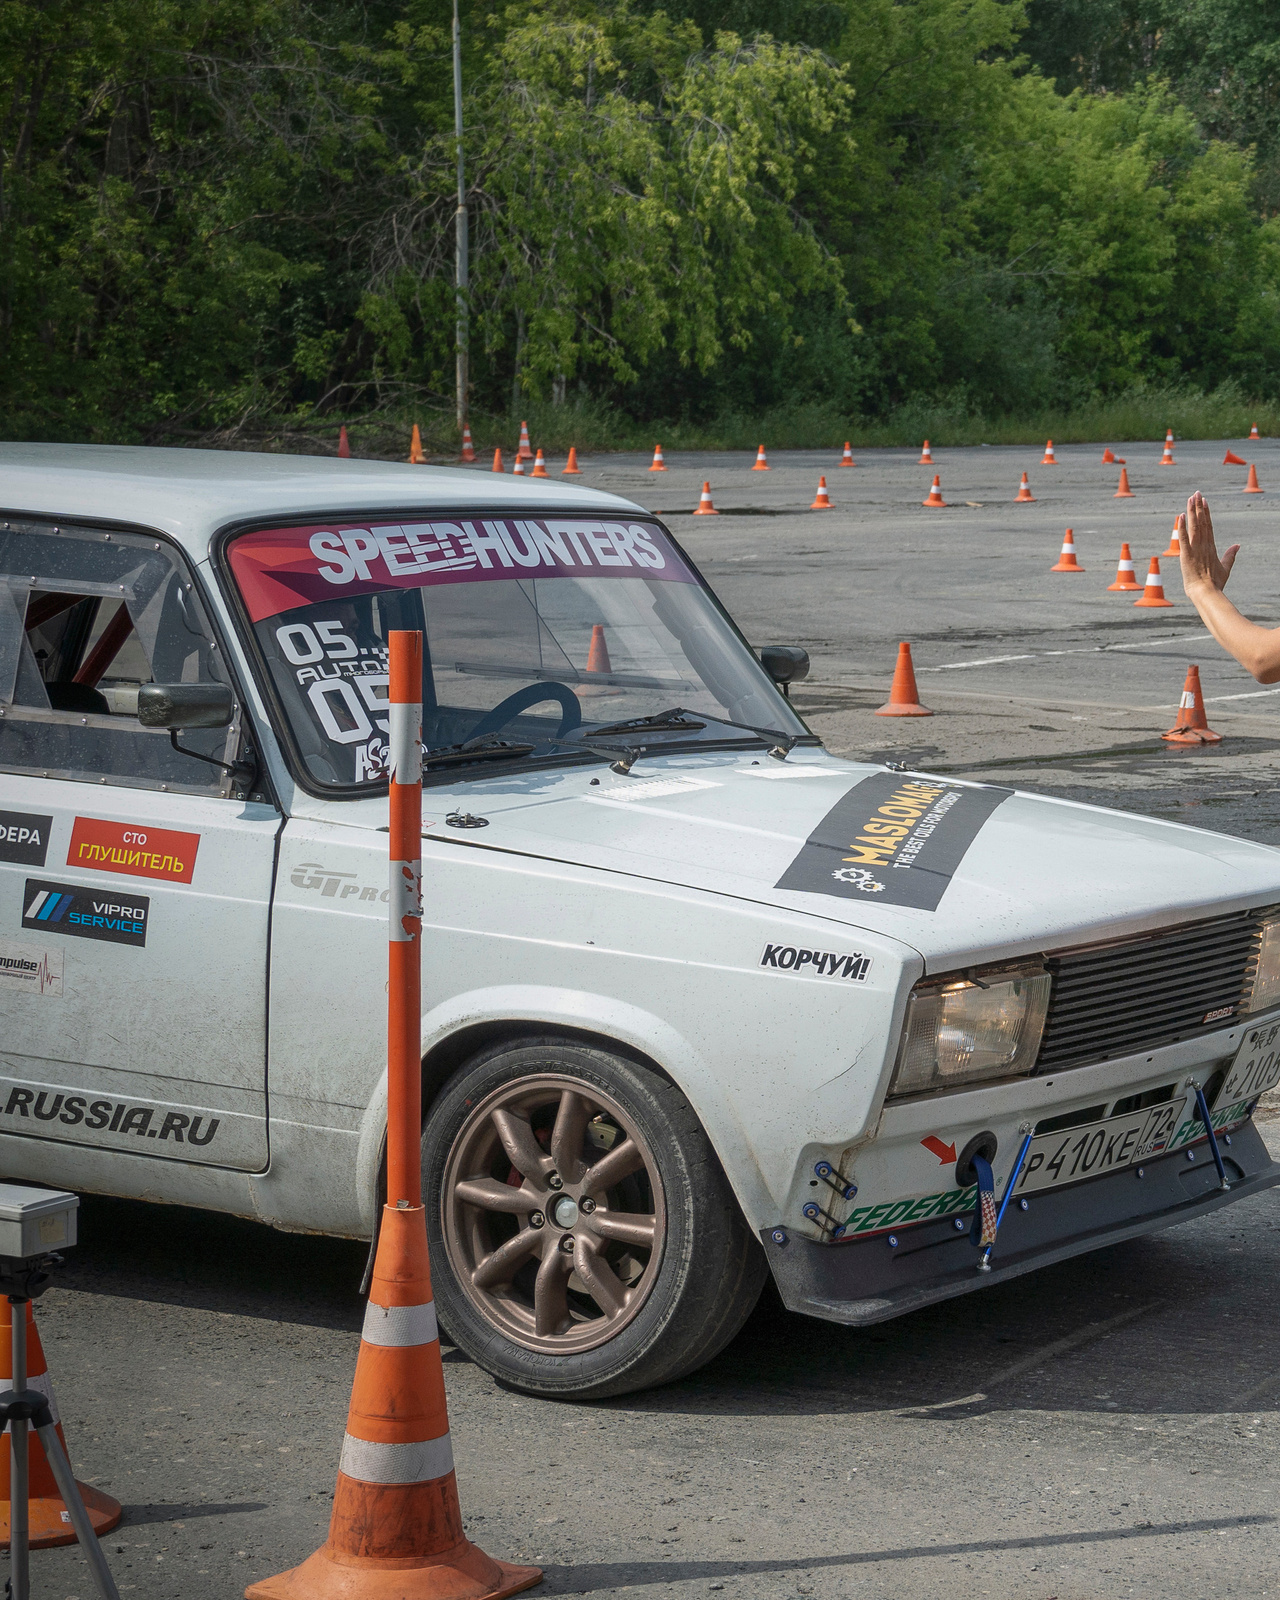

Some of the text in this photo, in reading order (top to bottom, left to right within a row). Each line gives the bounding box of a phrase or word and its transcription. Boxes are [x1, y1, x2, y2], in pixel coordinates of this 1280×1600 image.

[309, 520, 666, 584] SPEEDHUNTERS
[276, 620, 358, 665] 05
[922, 812, 944, 825] FOR
[123, 831, 147, 846] СТО
[913, 823, 936, 838] OILS
[902, 837, 926, 854] BEST
[78, 843, 185, 873] ГЛУШИТЕЛЬ
[893, 853, 915, 868] THE
[92, 901, 145, 920] VIPRO
[69, 912, 144, 934] SERVICE
[761, 944, 871, 980] КОРЧУЙ!
[1206, 1006, 1234, 1020] SPORT
[1143, 1106, 1174, 1143] 72
[1135, 1141, 1154, 1157] RUS
[851, 1183, 977, 1232] FEDERA
